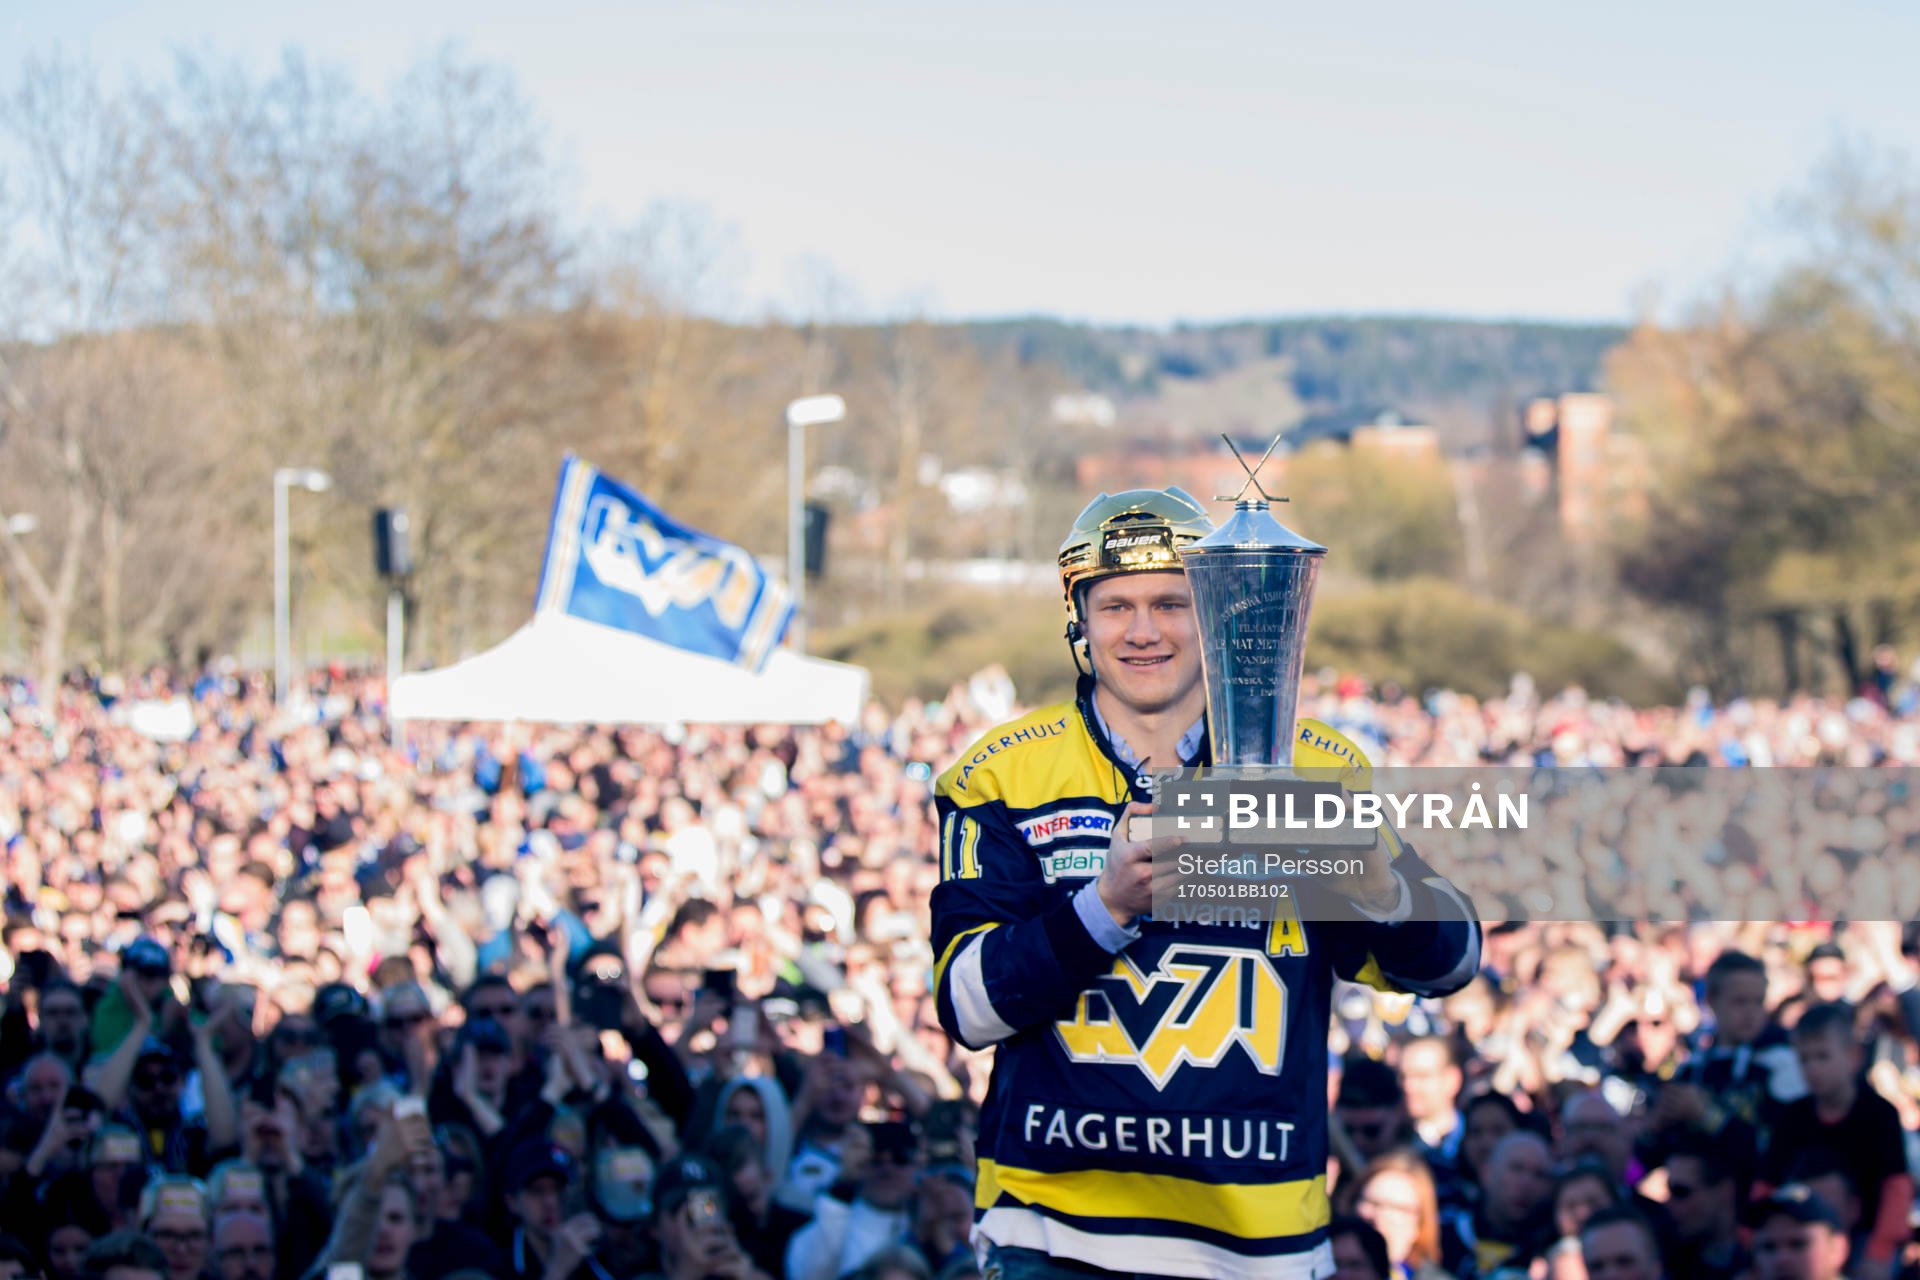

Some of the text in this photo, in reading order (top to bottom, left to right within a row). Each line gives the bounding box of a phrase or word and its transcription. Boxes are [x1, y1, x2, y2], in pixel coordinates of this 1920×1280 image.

[1105, 535, 1161, 549] BAUER
[1231, 638, 1254, 650] MAT
[956, 717, 1068, 790] FAGERHULT
[1297, 723, 1364, 774] RHULT
[942, 811, 983, 881] 11
[1032, 815, 1112, 839] INTERSPORT
[1266, 885, 1309, 958] A
[1024, 1104, 1295, 1162] FAGERHULT
